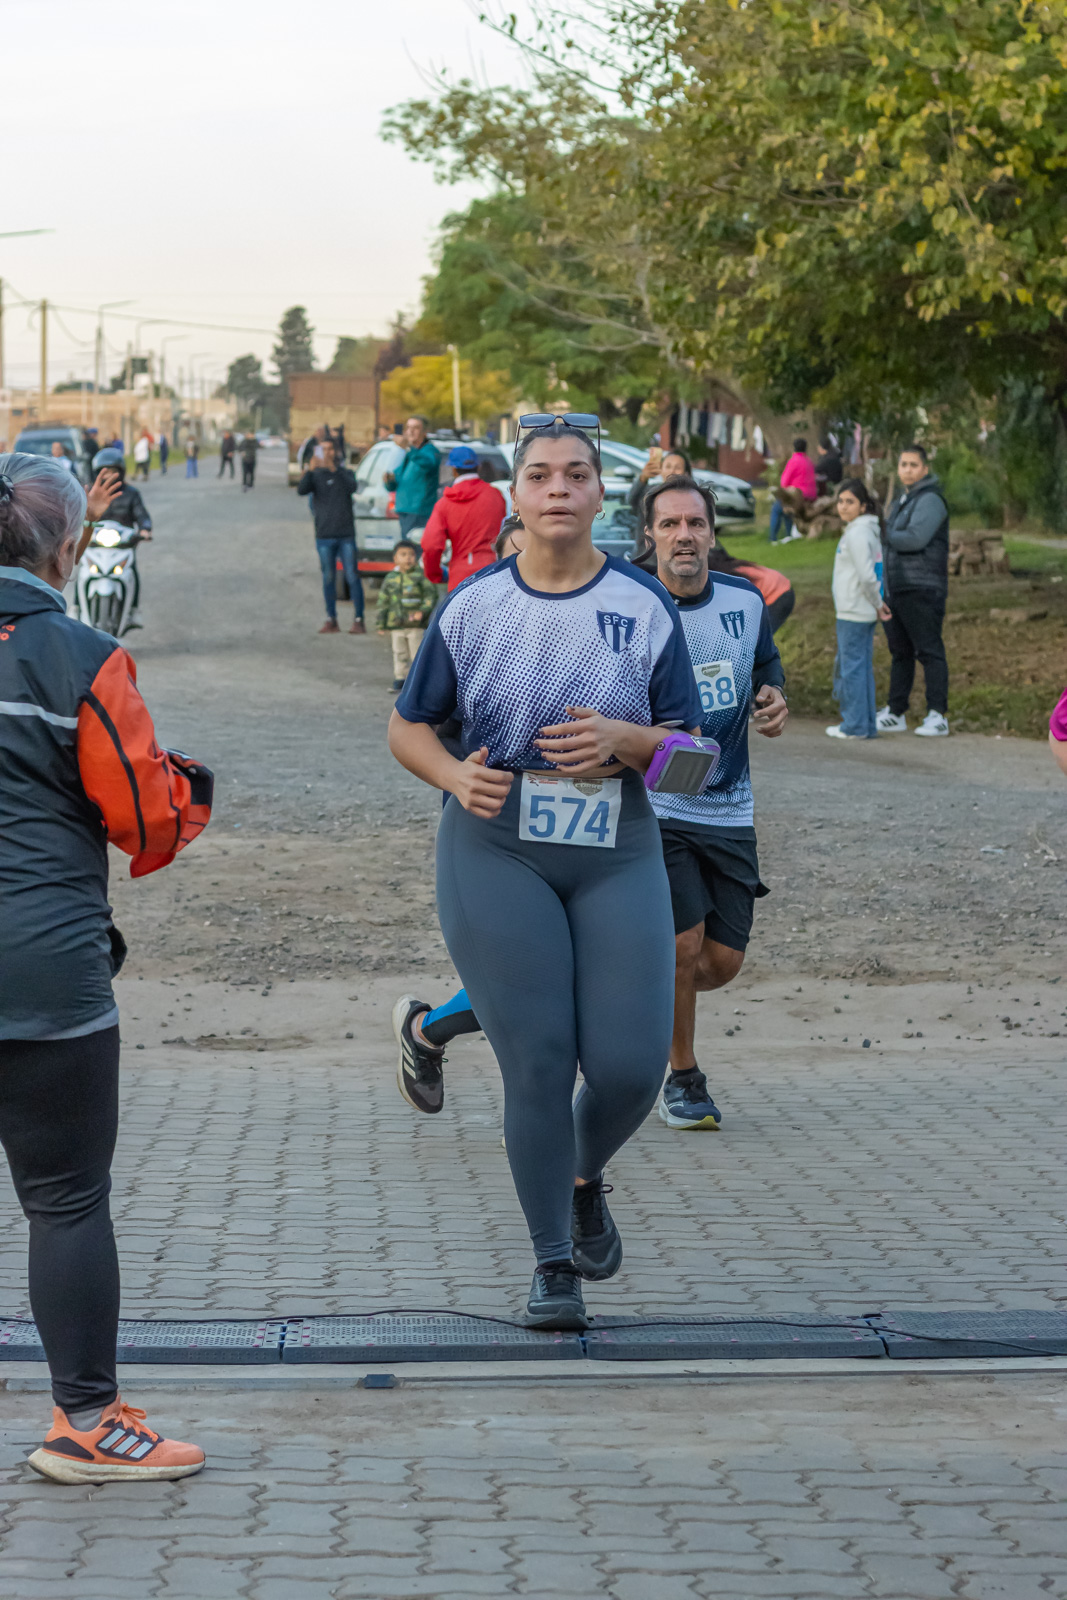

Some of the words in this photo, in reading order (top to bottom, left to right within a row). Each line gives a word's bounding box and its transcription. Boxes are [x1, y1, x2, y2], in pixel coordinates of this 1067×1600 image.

[603, 614, 629, 628] SFC
[724, 612, 741, 622] SFC
[696, 676, 735, 710] 68
[528, 795, 610, 843] 574
